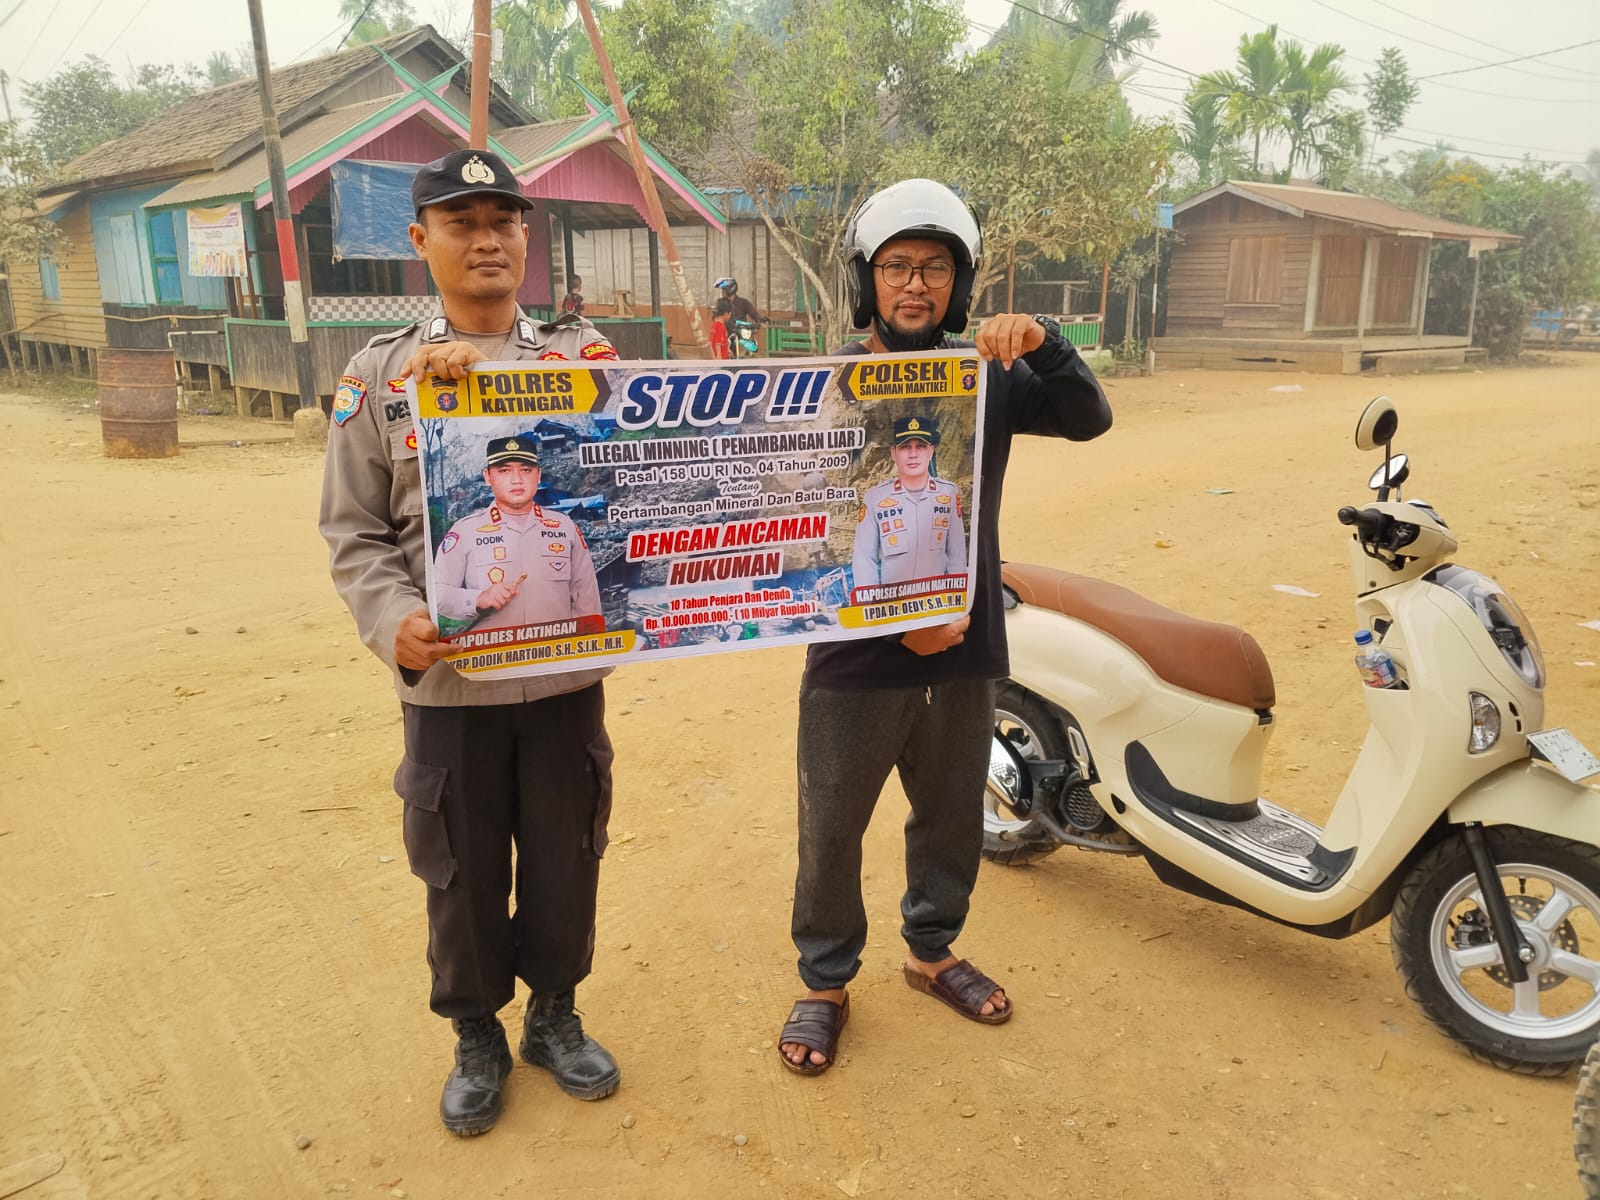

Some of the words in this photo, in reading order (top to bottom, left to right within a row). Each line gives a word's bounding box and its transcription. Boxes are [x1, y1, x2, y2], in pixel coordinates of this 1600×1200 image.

[859, 361, 948, 383] POLSEK
[477, 373, 572, 395] POLRES
[859, 383, 904, 396] SANAMAN
[905, 381, 947, 394] MANTIKEI
[481, 395, 574, 413] KATINGAN
[622, 373, 767, 424] STOP
[771, 370, 830, 416] !!!
[581, 444, 640, 464] ILLEGAL
[643, 438, 709, 460] MINNING
[721, 432, 824, 456] PENAMBANGAN
[827, 430, 856, 449] LIAR
[618, 470, 657, 483] Pasal
[661, 468, 686, 481] 158
[690, 465, 711, 478] UU
[715, 464, 729, 477] RI
[732, 462, 755, 476] No.
[758, 461, 774, 474] 04
[777, 458, 817, 473] Tahun
[820, 456, 848, 470] 2009
[719, 479, 761, 496] Tentang
[610, 502, 713, 521] Pertambangan
[716, 496, 764, 512] Mineral
[767, 493, 792, 507] Dan
[795, 490, 824, 505] Batu
[826, 488, 856, 502] Bara
[876, 507, 904, 520] DEDY
[476, 535, 504, 545] DODIK
[541, 530, 566, 538] POLRI
[629, 521, 719, 559] DENGAN
[722, 515, 828, 549] ANCAMAN
[670, 551, 781, 586] HUKUMAN
[670, 600, 680, 611] 10
[682, 596, 708, 610] Tahun
[710, 594, 743, 608] Penjara
[745, 592, 762, 603] Dan
[763, 589, 791, 602] Denda
[856, 586, 898, 602] KAPOLSEK
[645, 617, 660, 631] Rp.
[739, 608, 750, 620] 10
[751, 604, 779, 619] Milyar
[780, 602, 811, 618] Rupiah
[888, 603, 901, 617] Dr.
[516, 621, 577, 641] KATINGAN
[471, 651, 503, 669] DODIK
[505, 645, 554, 663] HARTONO,
[555, 642, 576, 656] S.H.,
[605, 635, 625, 650] M.H.
